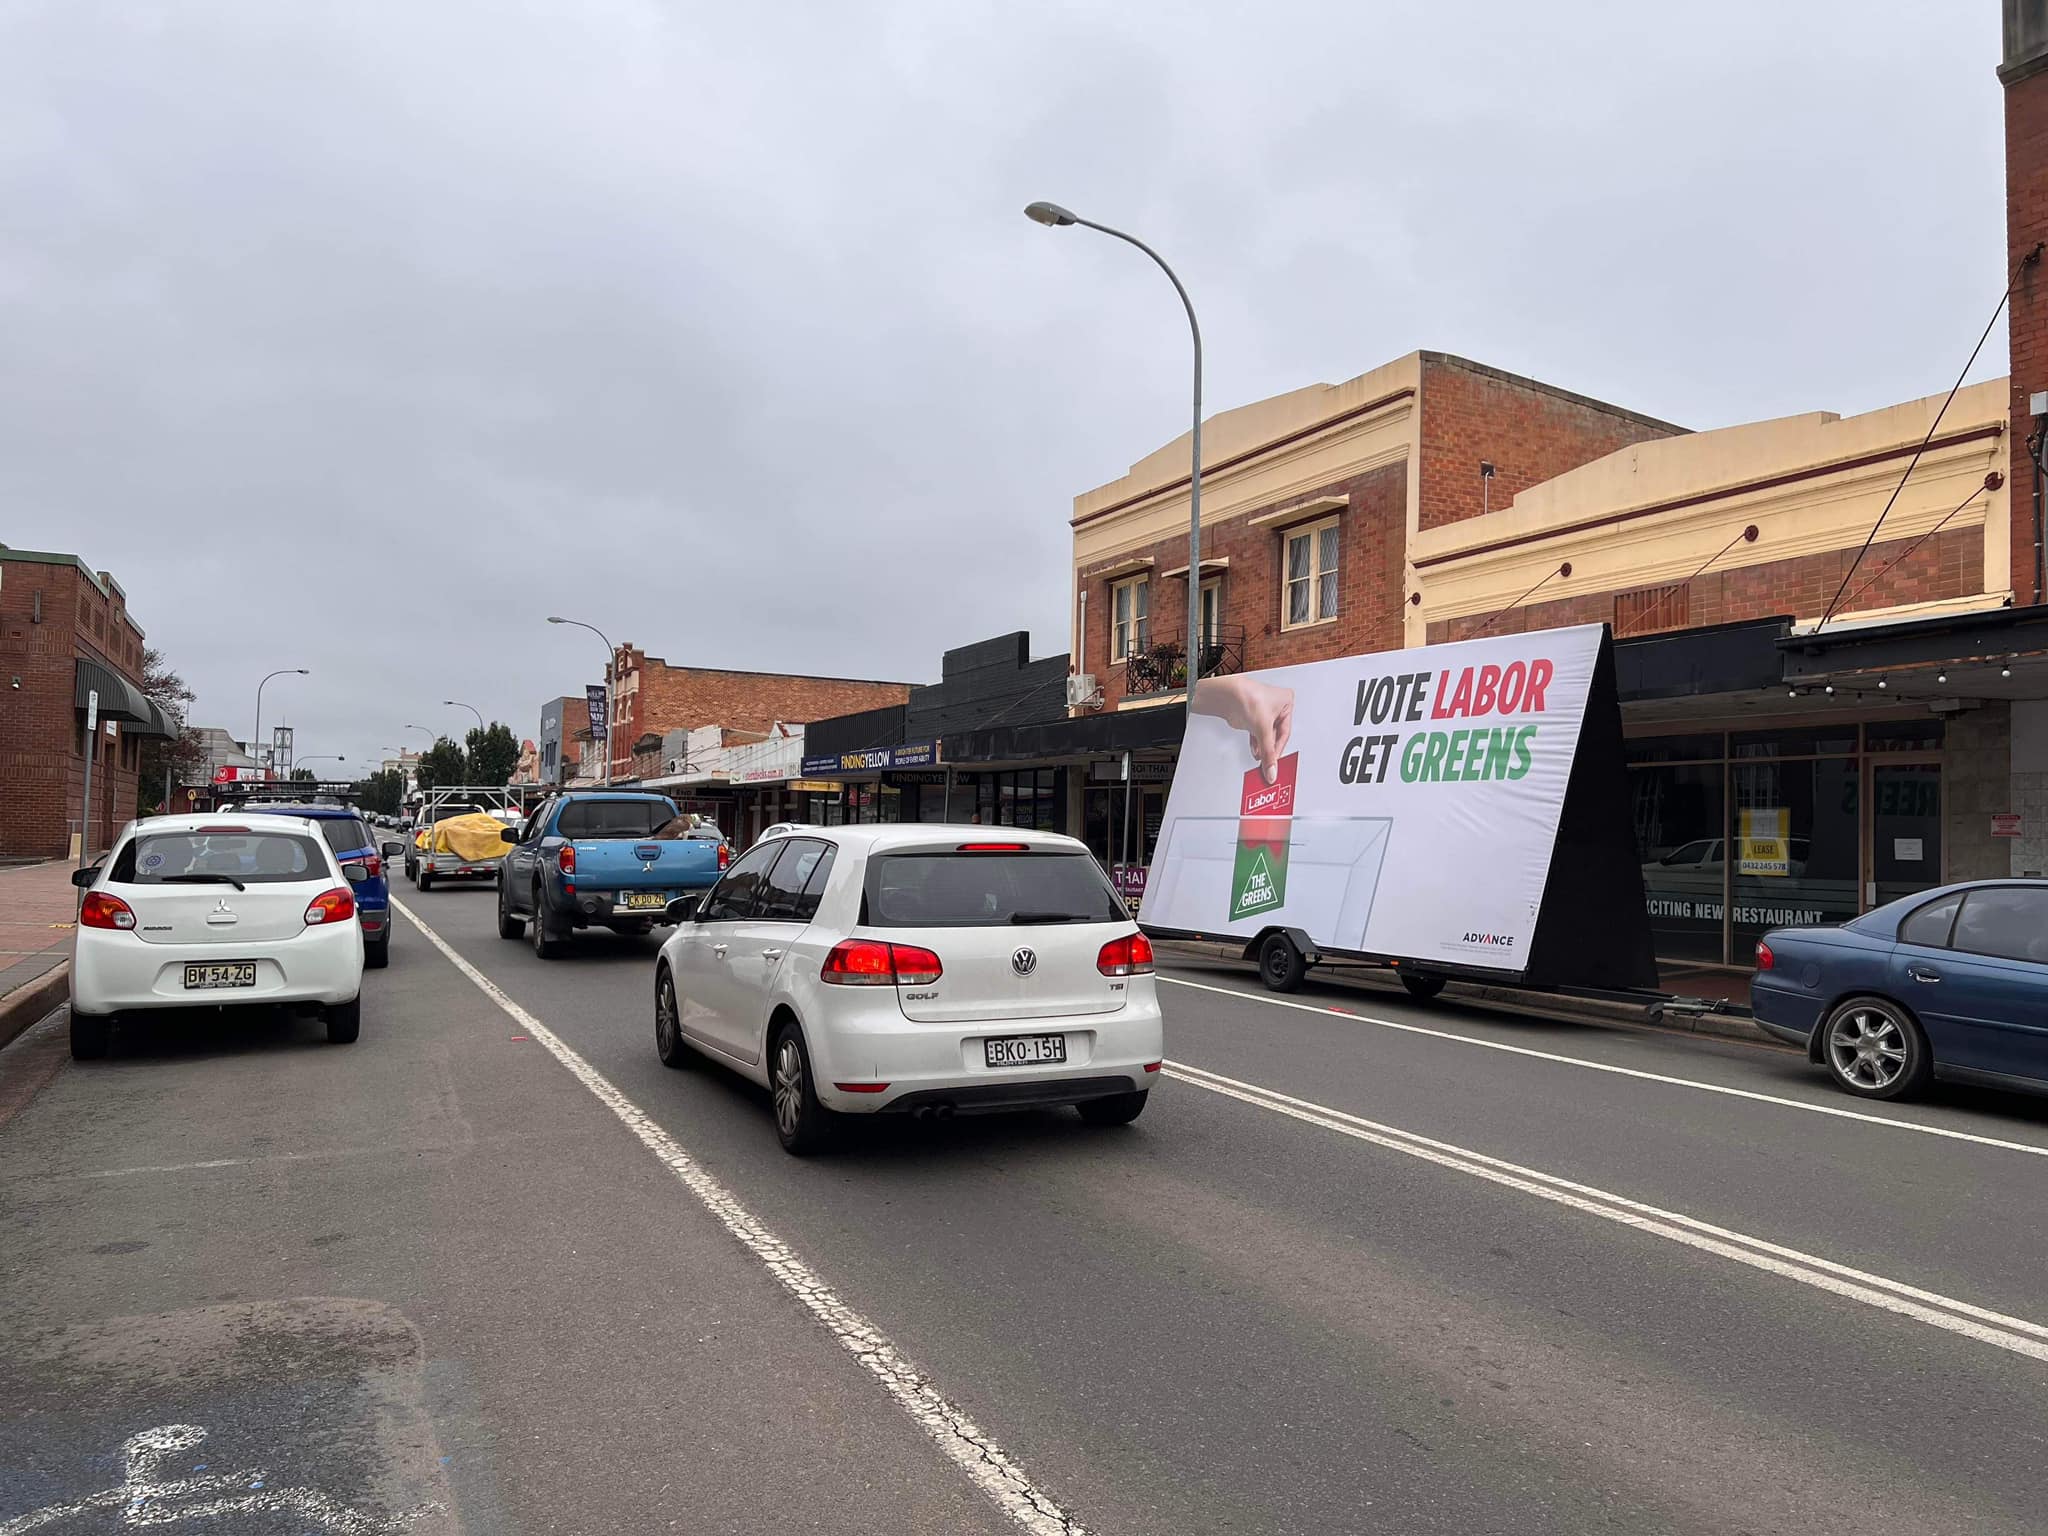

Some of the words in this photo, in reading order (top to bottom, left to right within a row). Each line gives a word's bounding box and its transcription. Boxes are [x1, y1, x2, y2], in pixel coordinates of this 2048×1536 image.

[1353, 671, 1432, 726] VOTE
[1430, 658, 1554, 720] LABOR
[1339, 734, 1399, 785] GET
[1399, 725, 1538, 783] GREENS
[1148, 764, 1169, 773] THAI
[1248, 790, 1277, 810] Labor
[1753, 844, 1774, 855] LEASE
[1115, 871, 1144, 884] THAI
[1251, 872, 1266, 890] THE
[1241, 886, 1272, 907] GREENS
[1646, 900, 1691, 918] XCITING
[1695, 903, 1725, 921] NEW
[1733, 907, 1823, 926] RESTAURANT
[1462, 932, 1514, 946] ADVANCE
[1110, 983, 1124, 991] TSI
[906, 992, 939, 1000] GOLF
